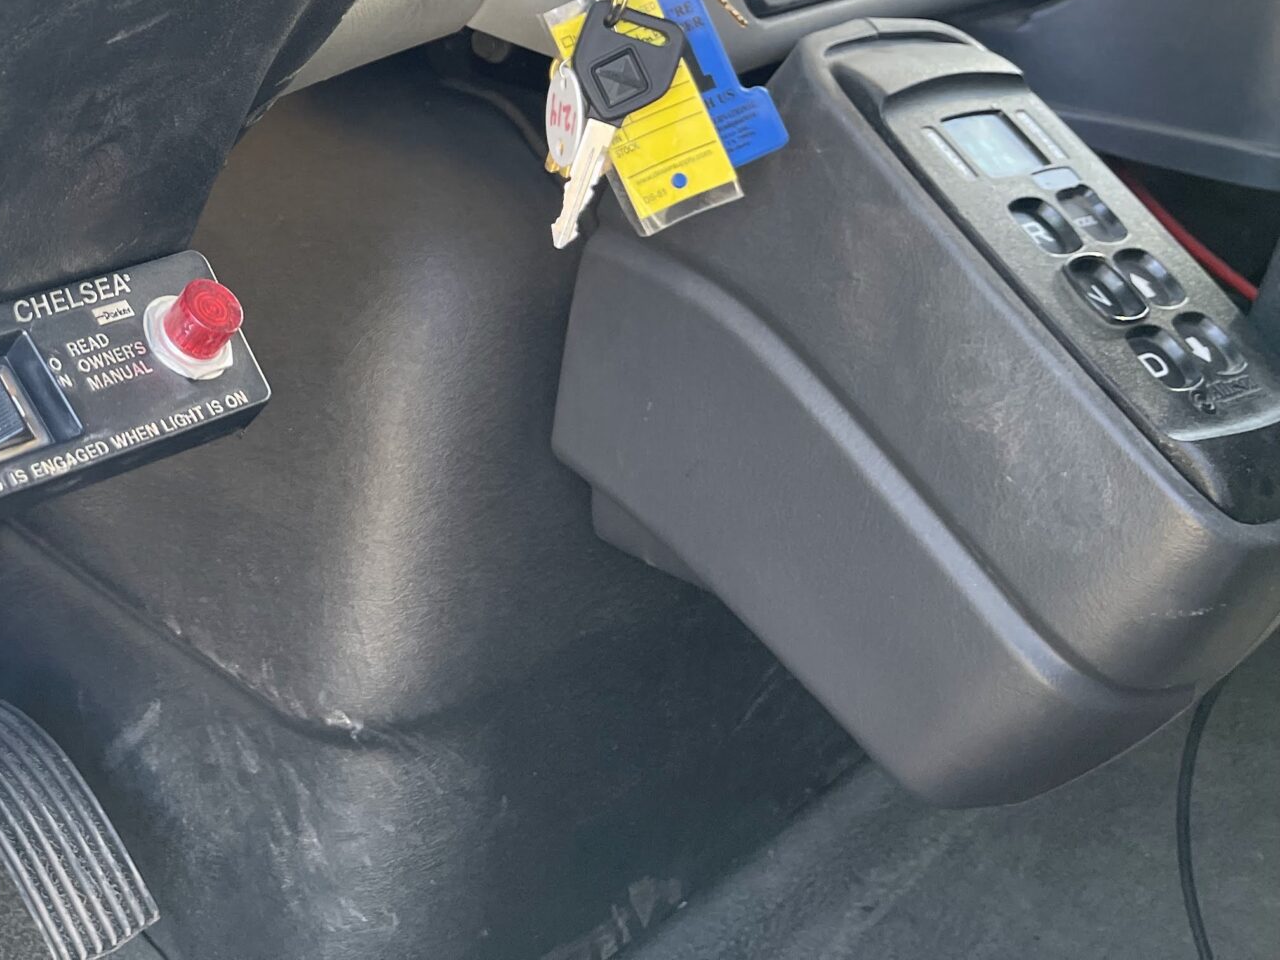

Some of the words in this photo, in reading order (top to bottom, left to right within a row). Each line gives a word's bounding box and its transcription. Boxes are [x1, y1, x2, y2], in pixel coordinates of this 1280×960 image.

[13, 273, 131, 322] CHELSEA
[66, 332, 110, 357] READ
[77, 341, 147, 372] OWNER'S
[86, 360, 154, 391] MANUAL
[1137, 352, 1169, 378] D
[9, 469, 29, 486] IS
[31, 440, 109, 478] ENGAGED
[109, 422, 161, 451] WHEN
[160, 406, 205, 432] LIGHT
[206, 399, 224, 417] IS
[224, 390, 249, 409] ON
